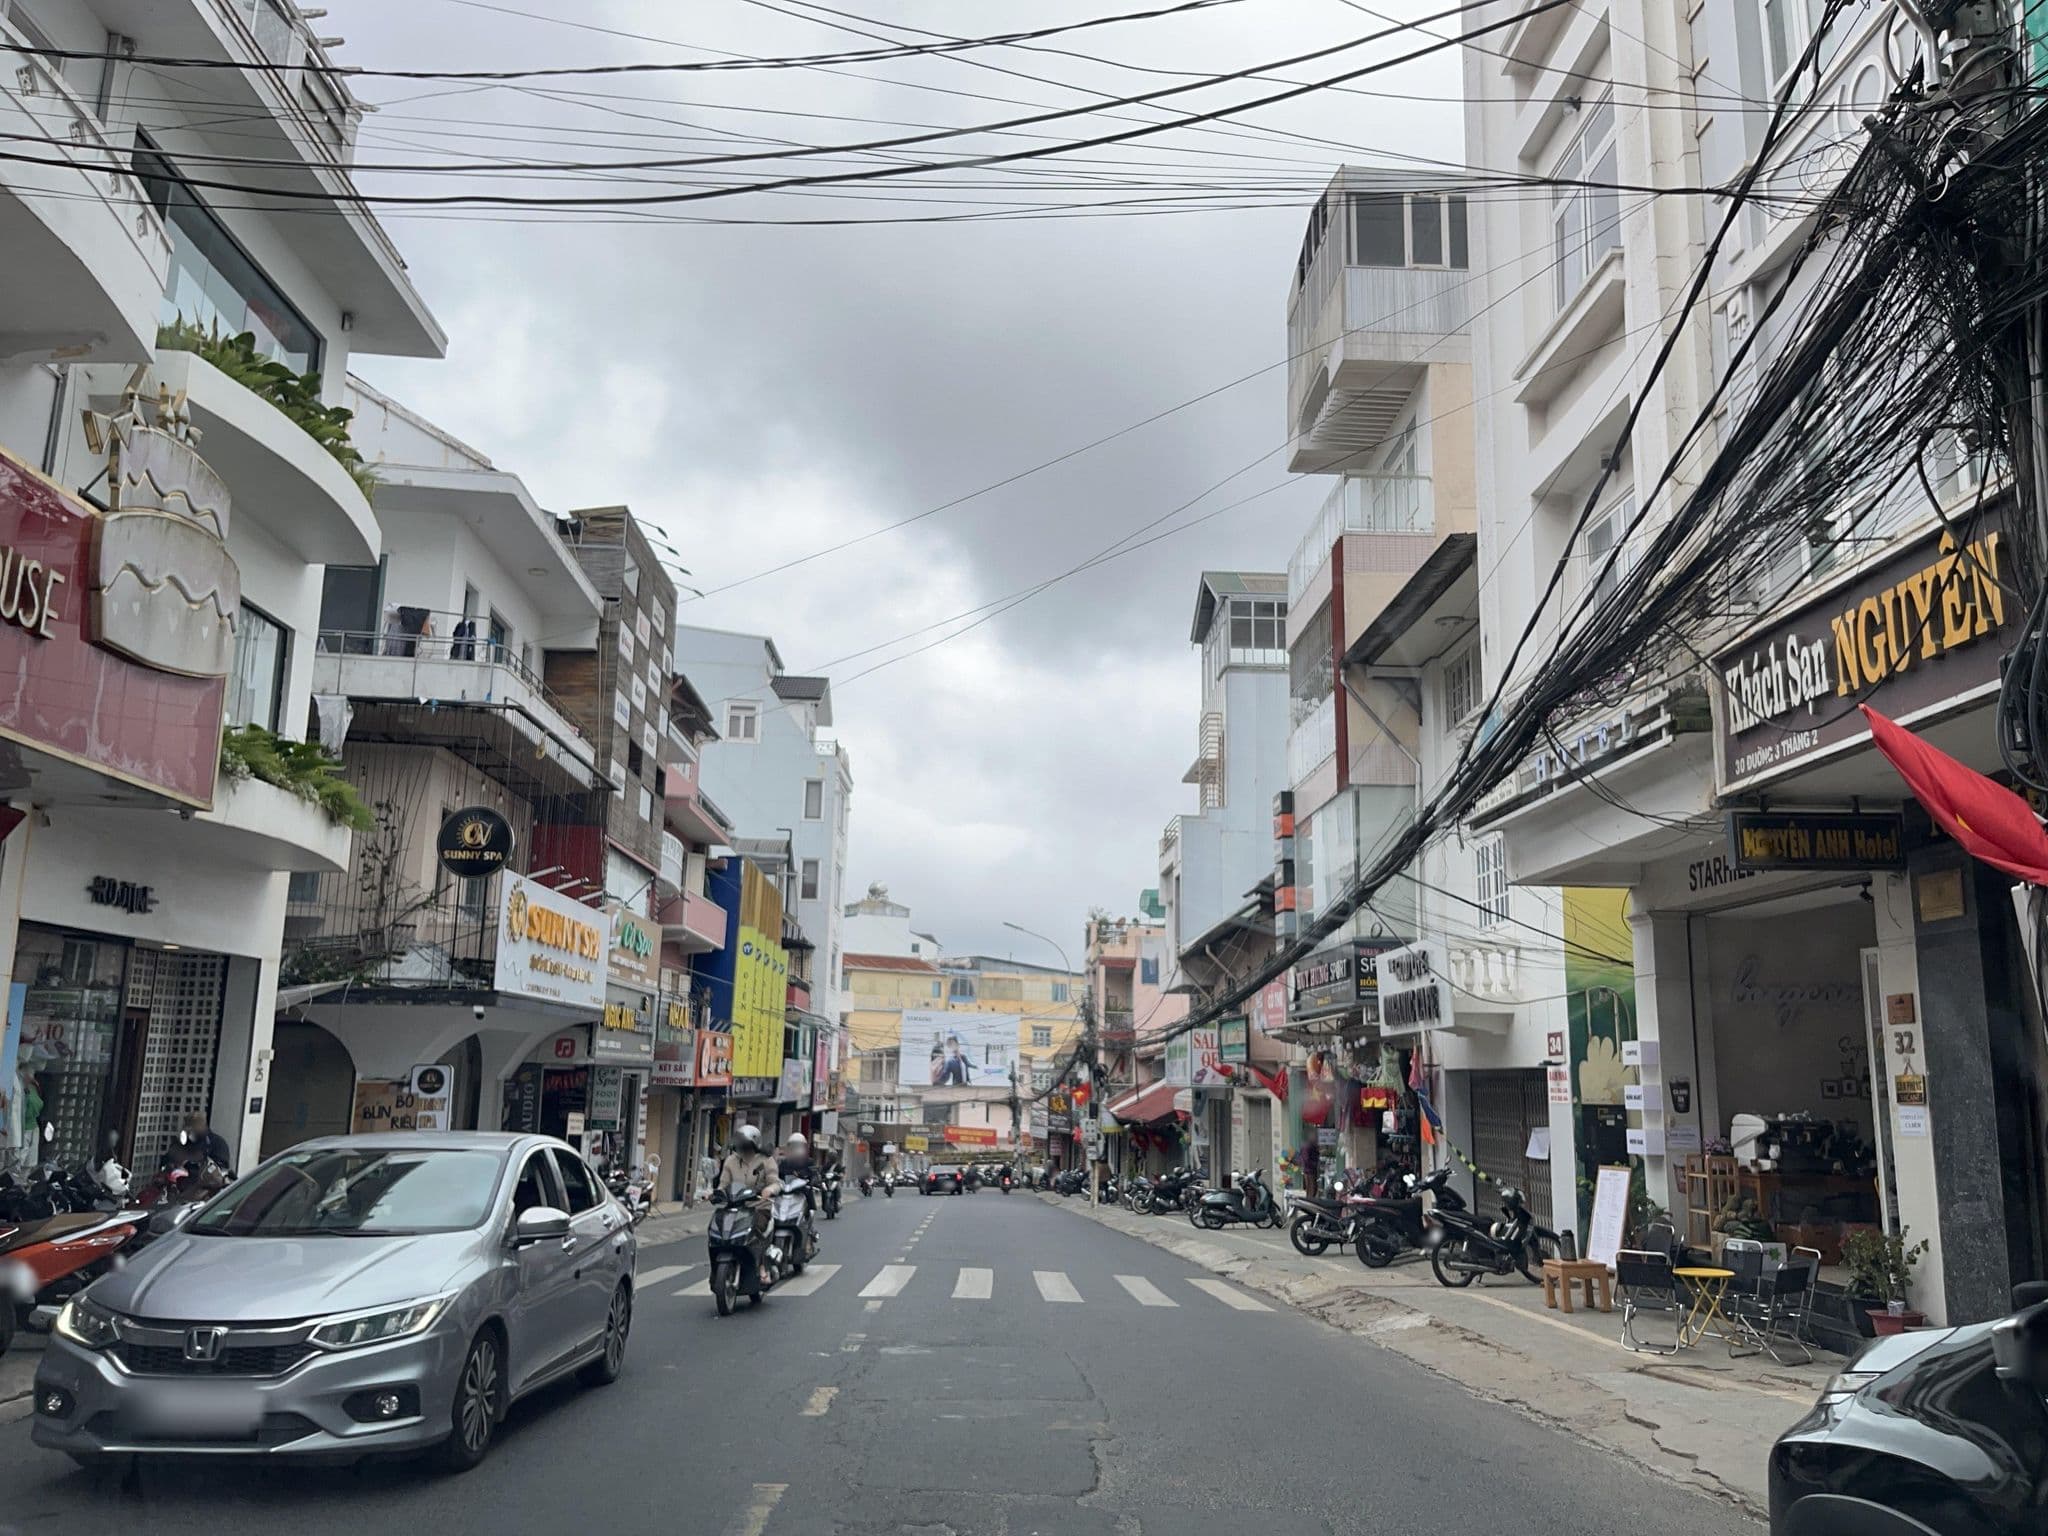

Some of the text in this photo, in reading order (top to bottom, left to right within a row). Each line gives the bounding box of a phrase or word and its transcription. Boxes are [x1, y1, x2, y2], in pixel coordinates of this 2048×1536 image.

[0, 546, 65, 640] USE
[1726, 530, 2004, 735] Khách Sạn NGUYÊN
[1735, 759, 1745, 775] 30
[1774, 744, 1780, 761] 3
[1781, 731, 1810, 757] THÁNG
[1812, 729, 1818, 746] 2
[443, 849, 503, 861] SUNNY SPA
[1815, 829, 1850, 858] ANH
[1854, 828, 1899, 860] Hotel
[1689, 854, 1755, 891] STARH
[526, 903, 601, 961] SUNNY SPA
[1330, 958, 1347, 981] SPORT
[1361, 957, 1376, 972] SP
[1194, 1032, 1218, 1049] SAL
[1549, 1036, 1561, 1053] 34
[1894, 1031, 1915, 1054] 32
[1201, 1051, 1218, 1068] OF
[651, 1076, 692, 1085] PHOTOCOPY
[521, 1083, 535, 1131] AUDIO
